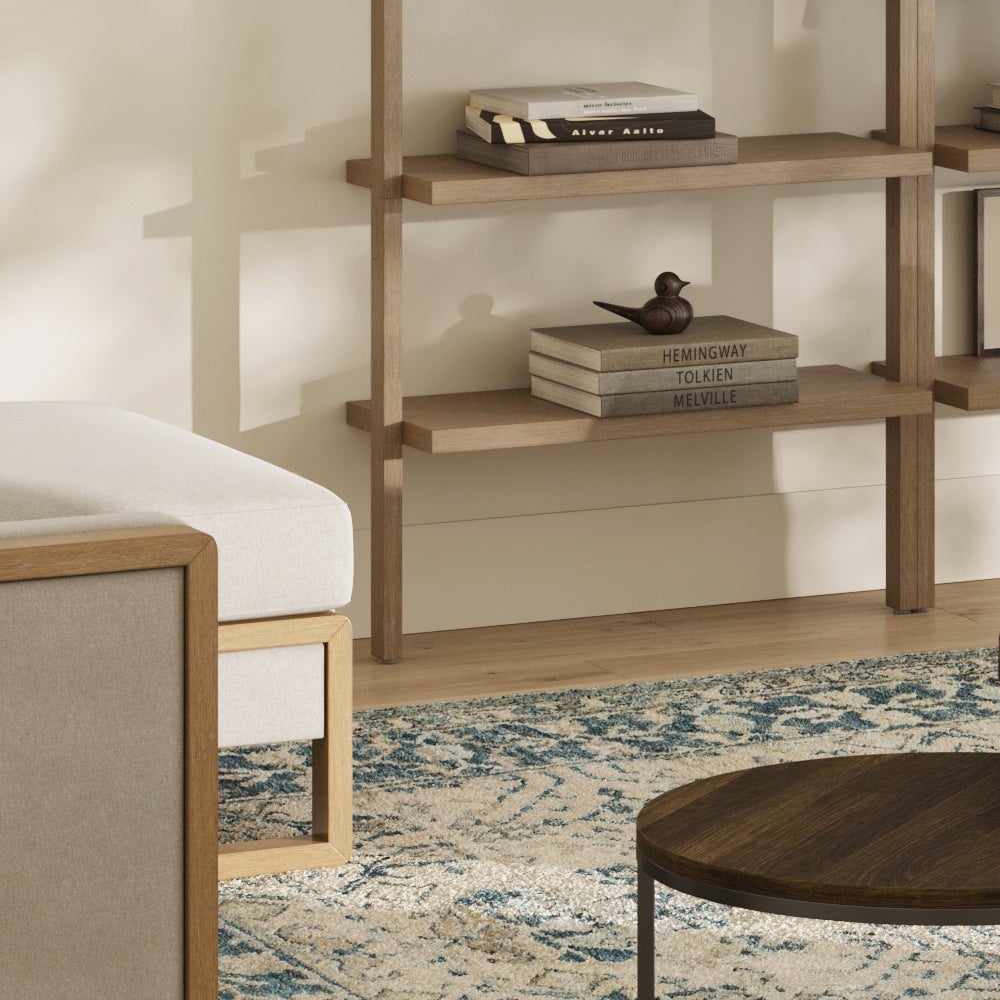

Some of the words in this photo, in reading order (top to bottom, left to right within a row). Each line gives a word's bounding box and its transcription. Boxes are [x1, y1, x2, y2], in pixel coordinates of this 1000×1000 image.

[623, 127, 664, 135] Aalto
[663, 344, 747, 363] HEMINGWAY
[676, 367, 733, 384] TOLKIEN
[673, 390, 737, 407] MELVILLE
